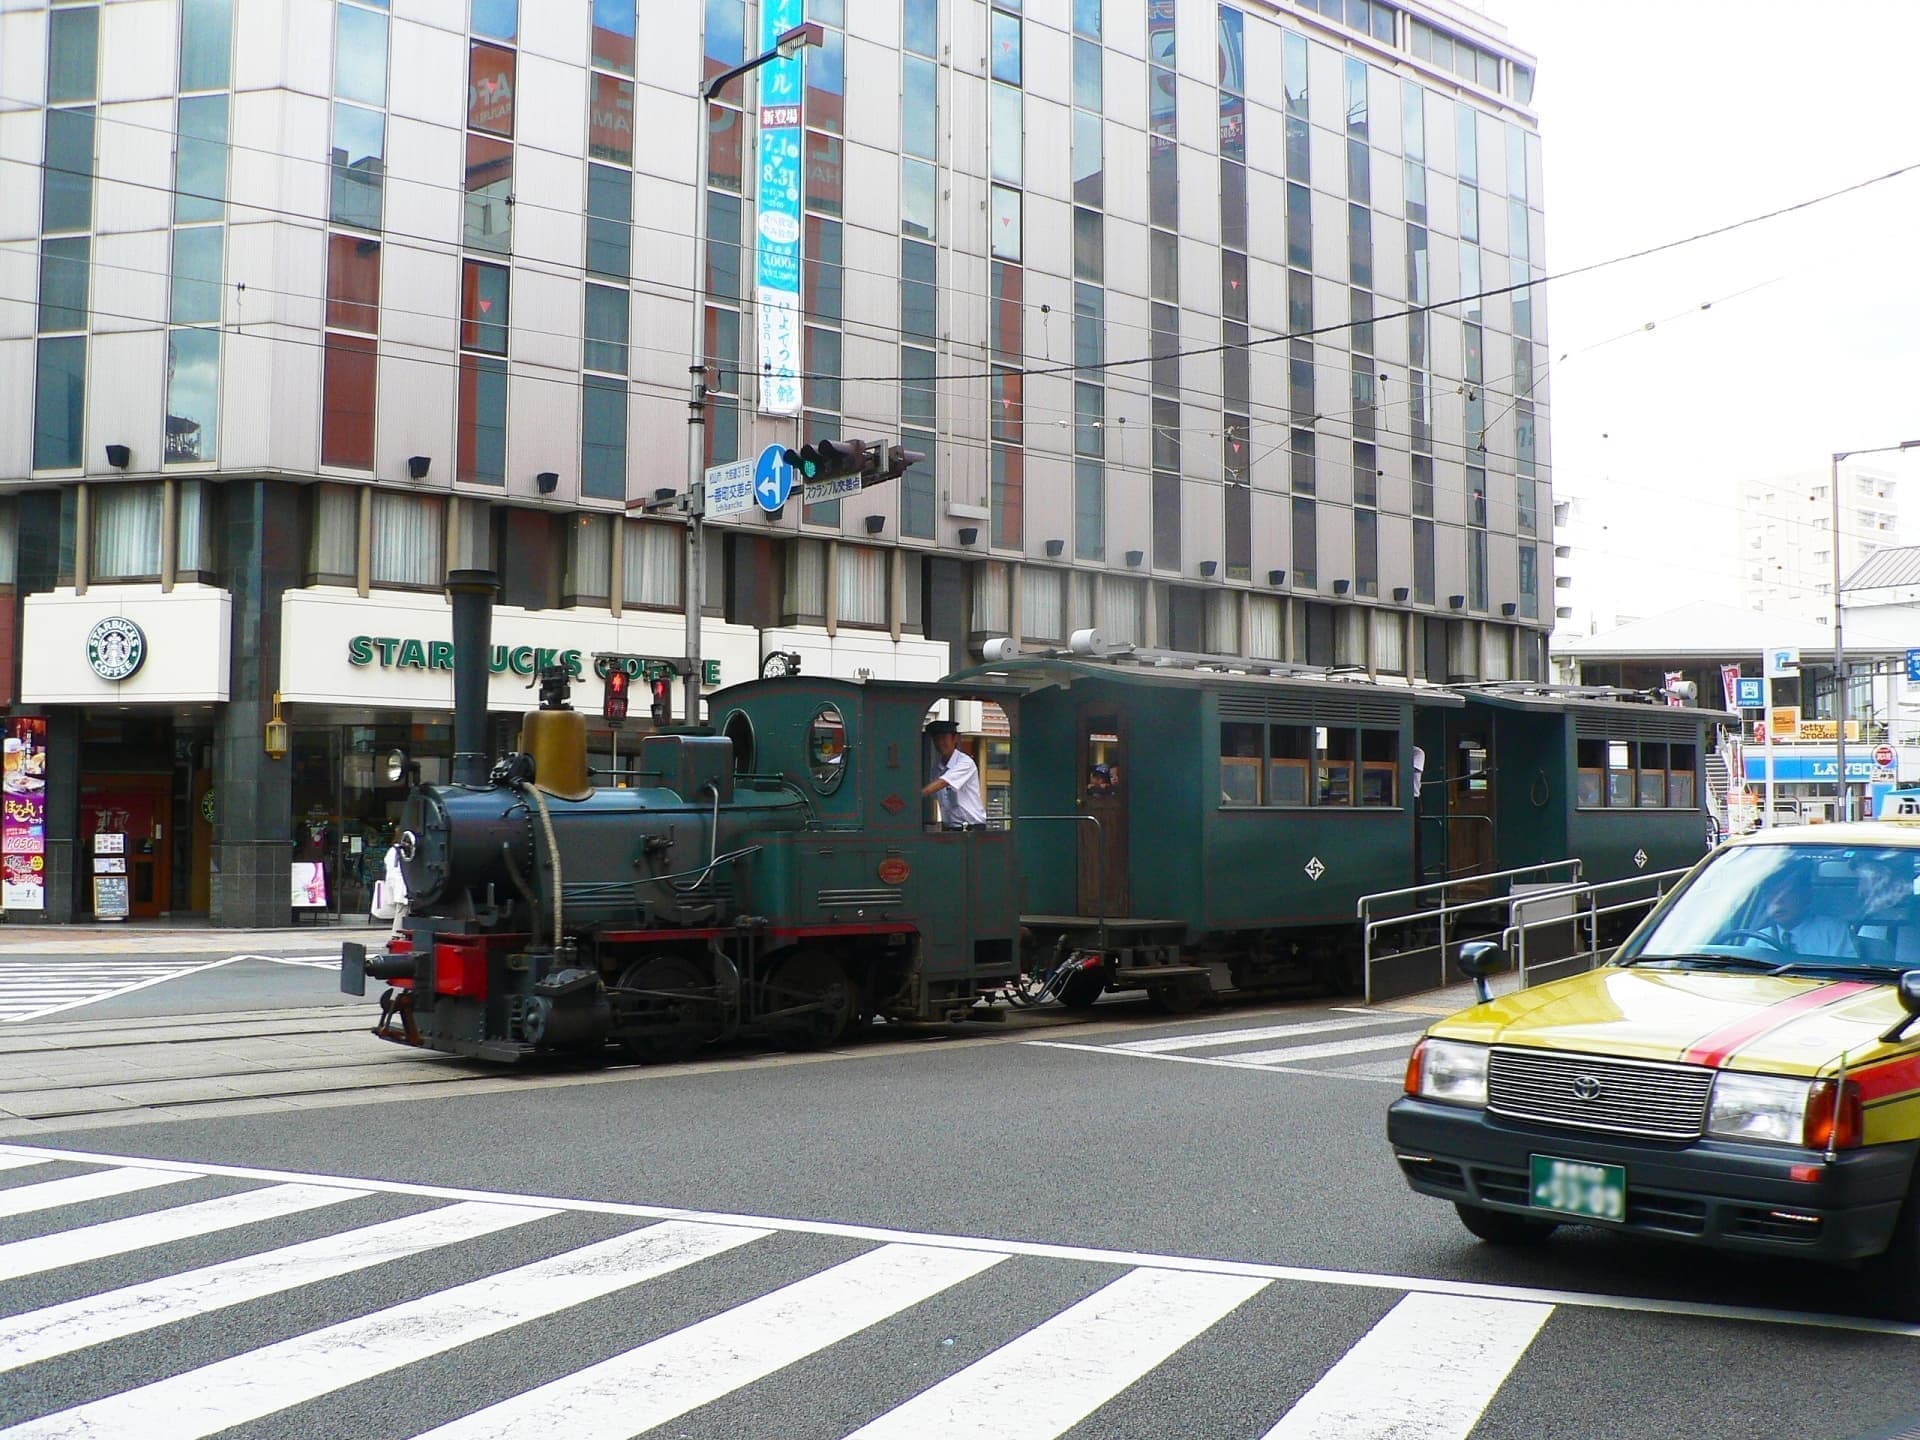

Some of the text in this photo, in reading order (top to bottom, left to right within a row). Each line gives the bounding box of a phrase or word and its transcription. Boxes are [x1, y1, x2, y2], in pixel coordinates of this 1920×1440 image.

[763, 108, 798, 126] 新登場
[707, 481, 752, 503] 一番町交差点
[805, 477, 860, 501] スクランブル交差点
[90, 620, 139, 648] STARBUCKS
[349, 635, 583, 677] STARUCKS
[94, 659, 134, 677] COFFEE
[1813, 763, 1873, 775] LASO
